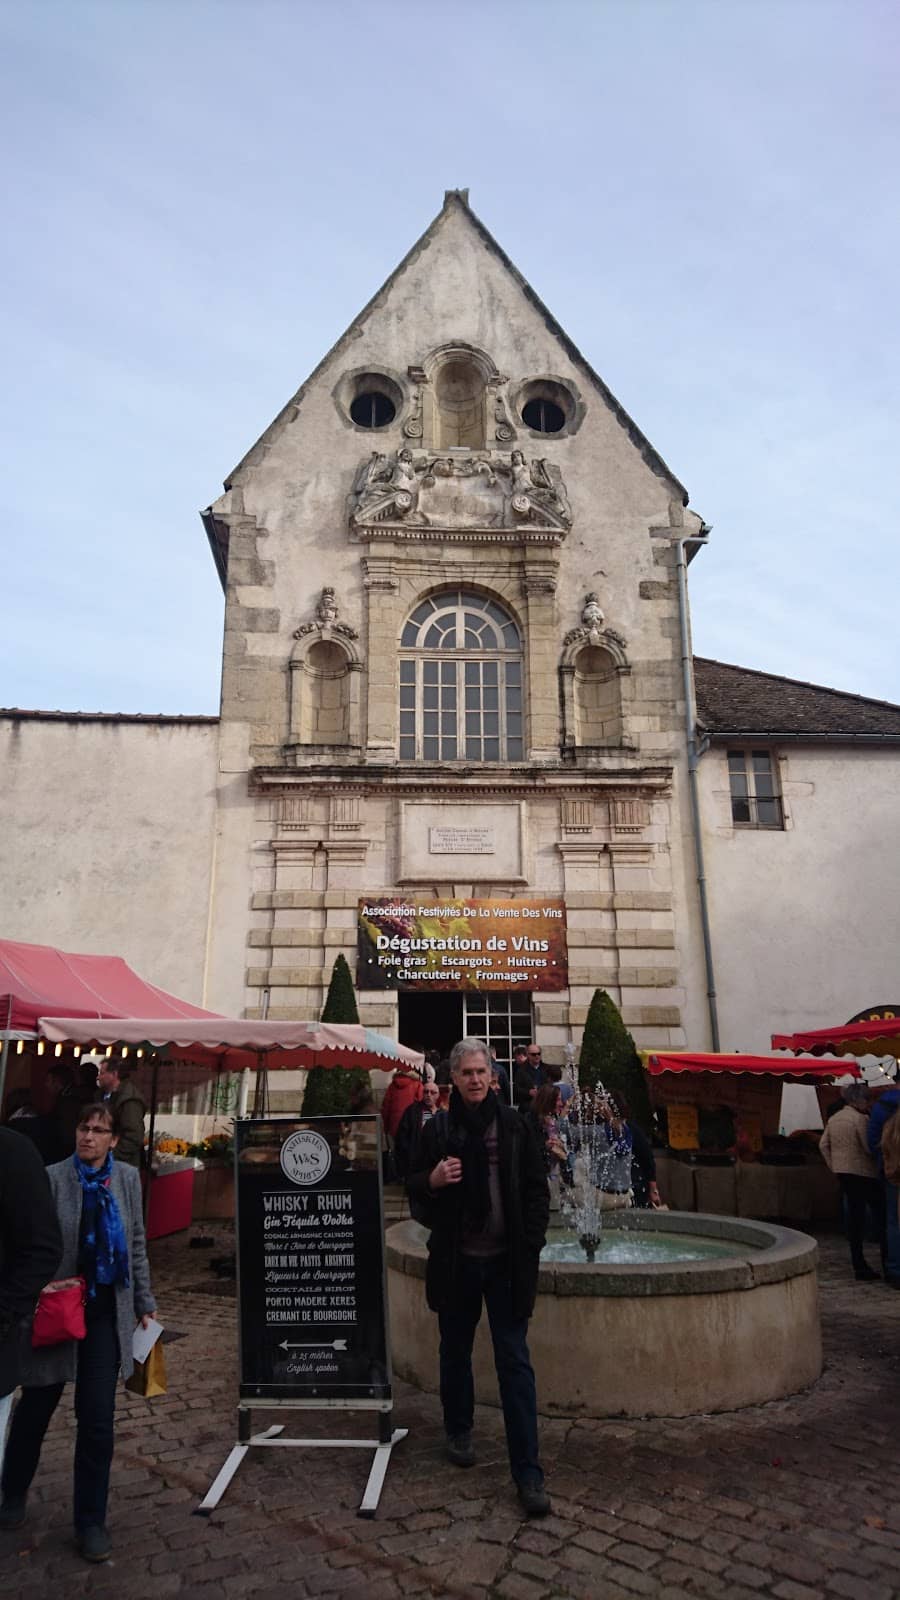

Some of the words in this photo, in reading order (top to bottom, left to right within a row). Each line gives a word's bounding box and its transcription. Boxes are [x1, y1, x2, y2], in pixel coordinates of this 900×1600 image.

[361, 905, 416, 917] Association
[418, 906, 461, 918] Festivités
[463, 907, 477, 918] De
[479, 907, 490, 918] La
[492, 907, 520, 918] Vente
[522, 907, 540, 918] Des
[542, 907, 562, 918] Vins
[376, 935, 482, 953] Dégustation
[486, 936, 508, 951] de
[511, 936, 549, 952] Vins
[378, 955, 402, 966] Foie
[403, 957, 427, 967] gras
[441, 956, 493, 968] Escargots
[396, 969, 461, 980] Charcuterie
[476, 970, 529, 982] Fromages
[263, 1195, 309, 1212] WHISKY
[317, 1194, 352, 1210] RHUM
[263, 1215, 281, 1230] Gin
[282, 1214, 320, 1230] Téquila
[321, 1213, 355, 1227] Vodka
[264, 1270, 299, 1283] Liqueurs
[301, 1271, 311, 1281] de
[313, 1270, 356, 1282] Bourgogne
[265, 1297, 292, 1306] PORTO
[294, 1296, 328, 1306] MADERE
[329, 1296, 356, 1306] XERES
[266, 1310, 300, 1321] CREMANT
[302, 1310, 312, 1321] DE
[313, 1310, 357, 1321] BOURGOGNE
